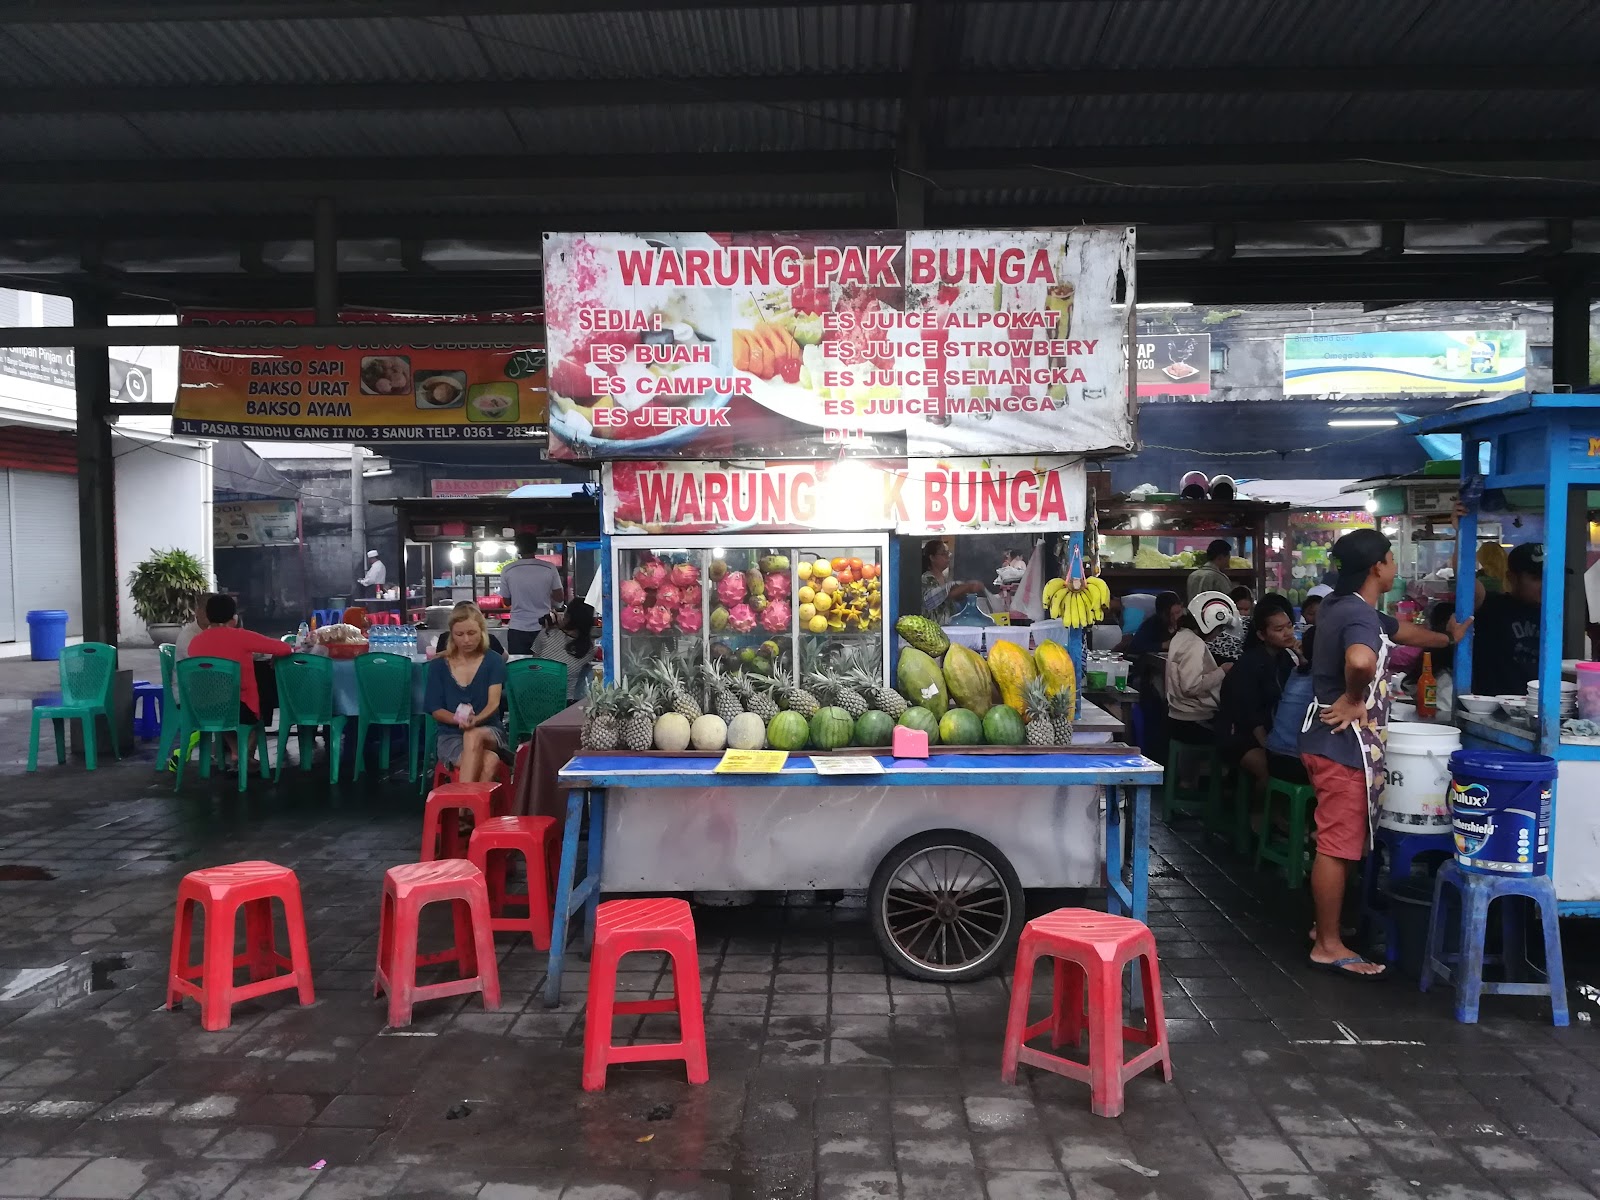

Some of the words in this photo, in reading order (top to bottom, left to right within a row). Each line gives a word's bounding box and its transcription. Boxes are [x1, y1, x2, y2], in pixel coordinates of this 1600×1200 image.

[617, 248, 803, 288] WARUNG
[815, 247, 901, 287] PAK
[911, 247, 1056, 285] BUNGA
[579, 309, 649, 331] SEDIA
[823, 312, 855, 329] ES
[862, 312, 938, 330] JUICE
[943, 310, 1060, 329] ALPOKAT
[38, 346, 63, 365] Pinjam
[592, 345, 626, 363] ES
[636, 345, 711, 363] BUAH
[823, 341, 855, 359] ES
[863, 341, 938, 359] JUICE
[943, 339, 1099, 358] STROWBERY
[1324, 352, 1353, 361] Omega
[184, 354, 233, 374] MENU
[250, 360, 302, 376] BAKSO
[307, 361, 345, 376] SAPI
[1124, 359, 1156, 370] RYCO
[592, 377, 626, 395] ES
[636, 377, 752, 395] CAMPUR
[823, 370, 855, 388] ES
[863, 370, 938, 388] JUICE
[944, 367, 1088, 387] SEMANGKA
[248, 381, 301, 397] BAKSO
[308, 381, 350, 397] URAT
[246, 400, 300, 417] BAKSO
[306, 401, 352, 417] AYAM
[824, 399, 855, 416] ES
[864, 399, 938, 416] JUICE
[946, 396, 1057, 414] MANGGA
[593, 408, 628, 426] ES
[634, 407, 731, 427] JERUK
[181, 421, 197, 433] JL.
[201, 422, 239, 436] PASAR
[242, 424, 291, 438] SINDHU
[294, 426, 330, 439] GANG
[333, 427, 344, 439] II
[347, 427, 368, 439] NO.
[371, 427, 379, 439] 3
[382, 427, 424, 439] SANUR
[428, 427, 460, 439] TELP.
[463, 427, 493, 438] 0361
[435, 480, 478, 490] BAKSO
[482, 480, 519, 490] CIPTA
[638, 471, 816, 524] WARUNG
[925, 469, 1068, 523] BUNGA
